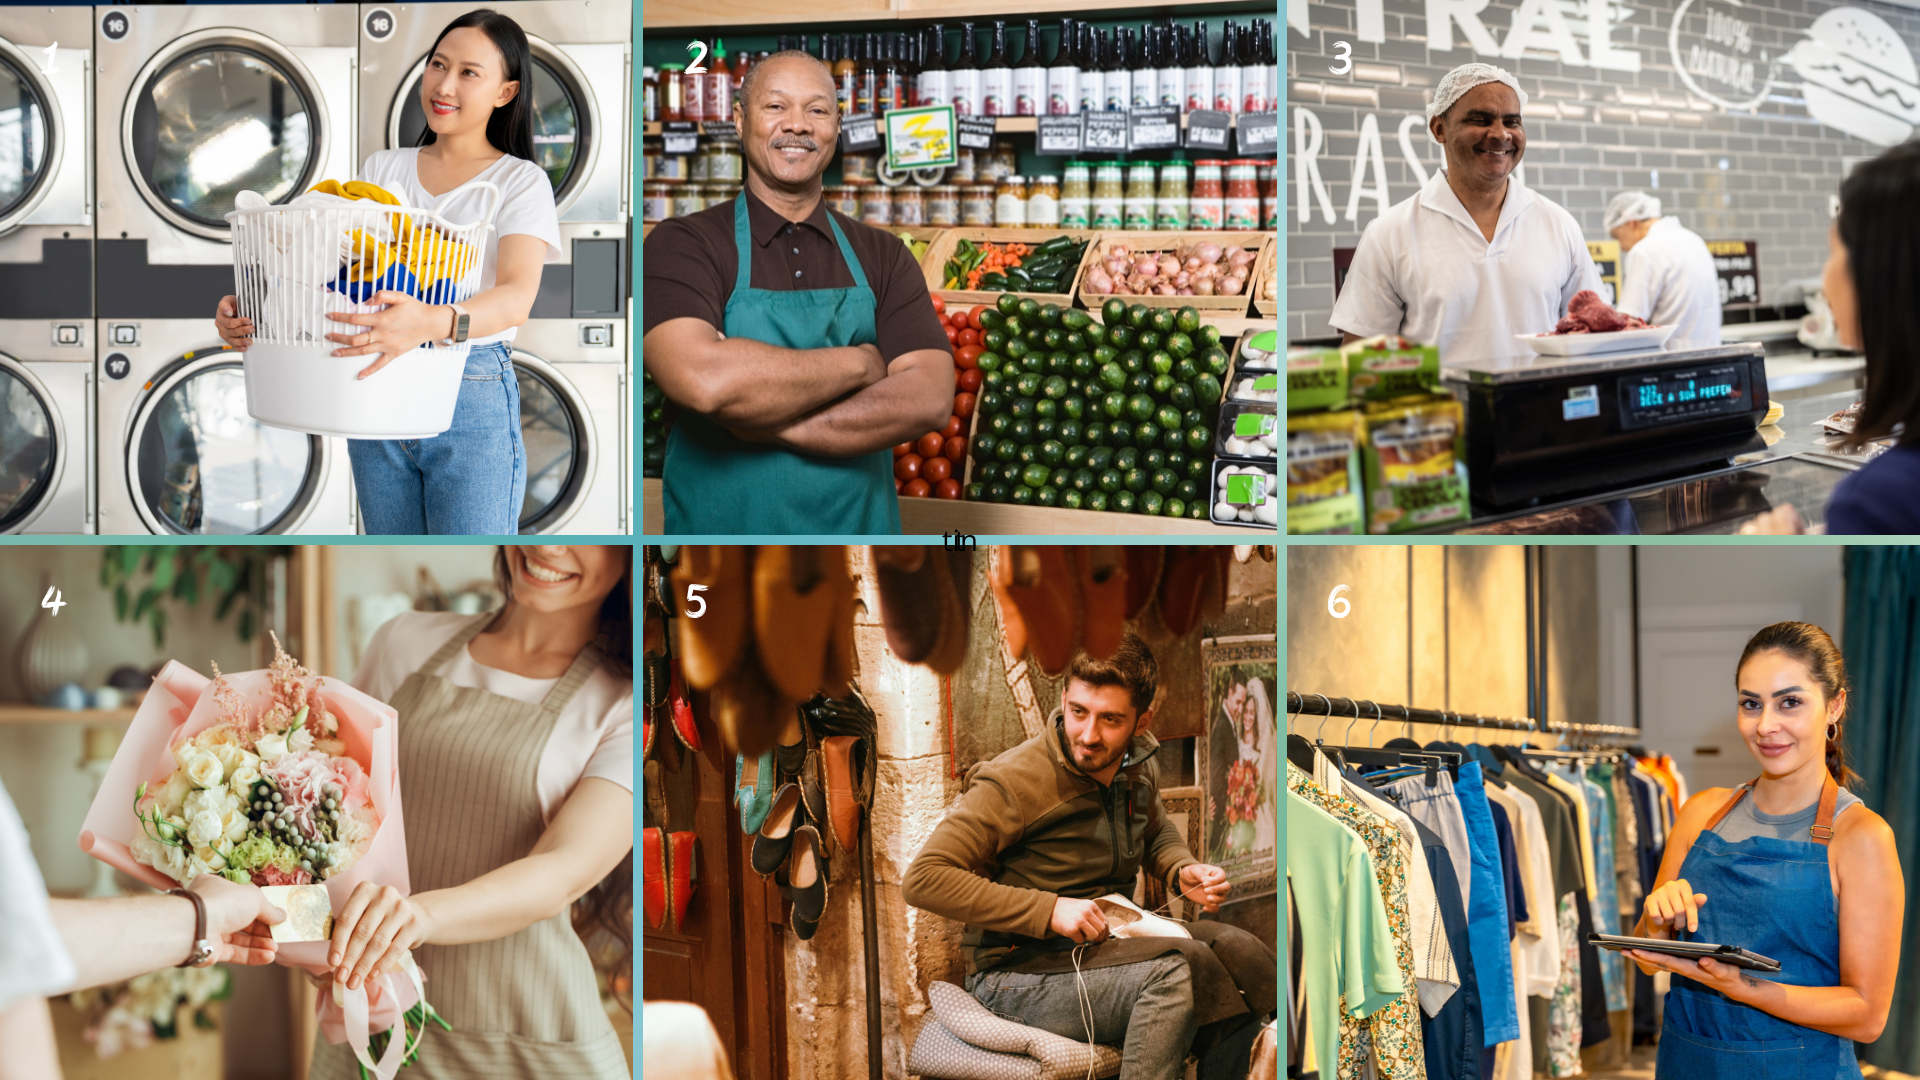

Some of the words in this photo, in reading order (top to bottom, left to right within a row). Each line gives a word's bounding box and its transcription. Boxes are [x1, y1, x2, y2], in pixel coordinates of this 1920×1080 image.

[108, 19, 124, 32] 16
[372, 18, 389, 31] 18
[1706, 6, 1751, 54] 100%
[1689, 44, 1755, 94] NATURAL
[958, 124, 994, 135] PEPPERS
[110, 361, 126, 373] 17
